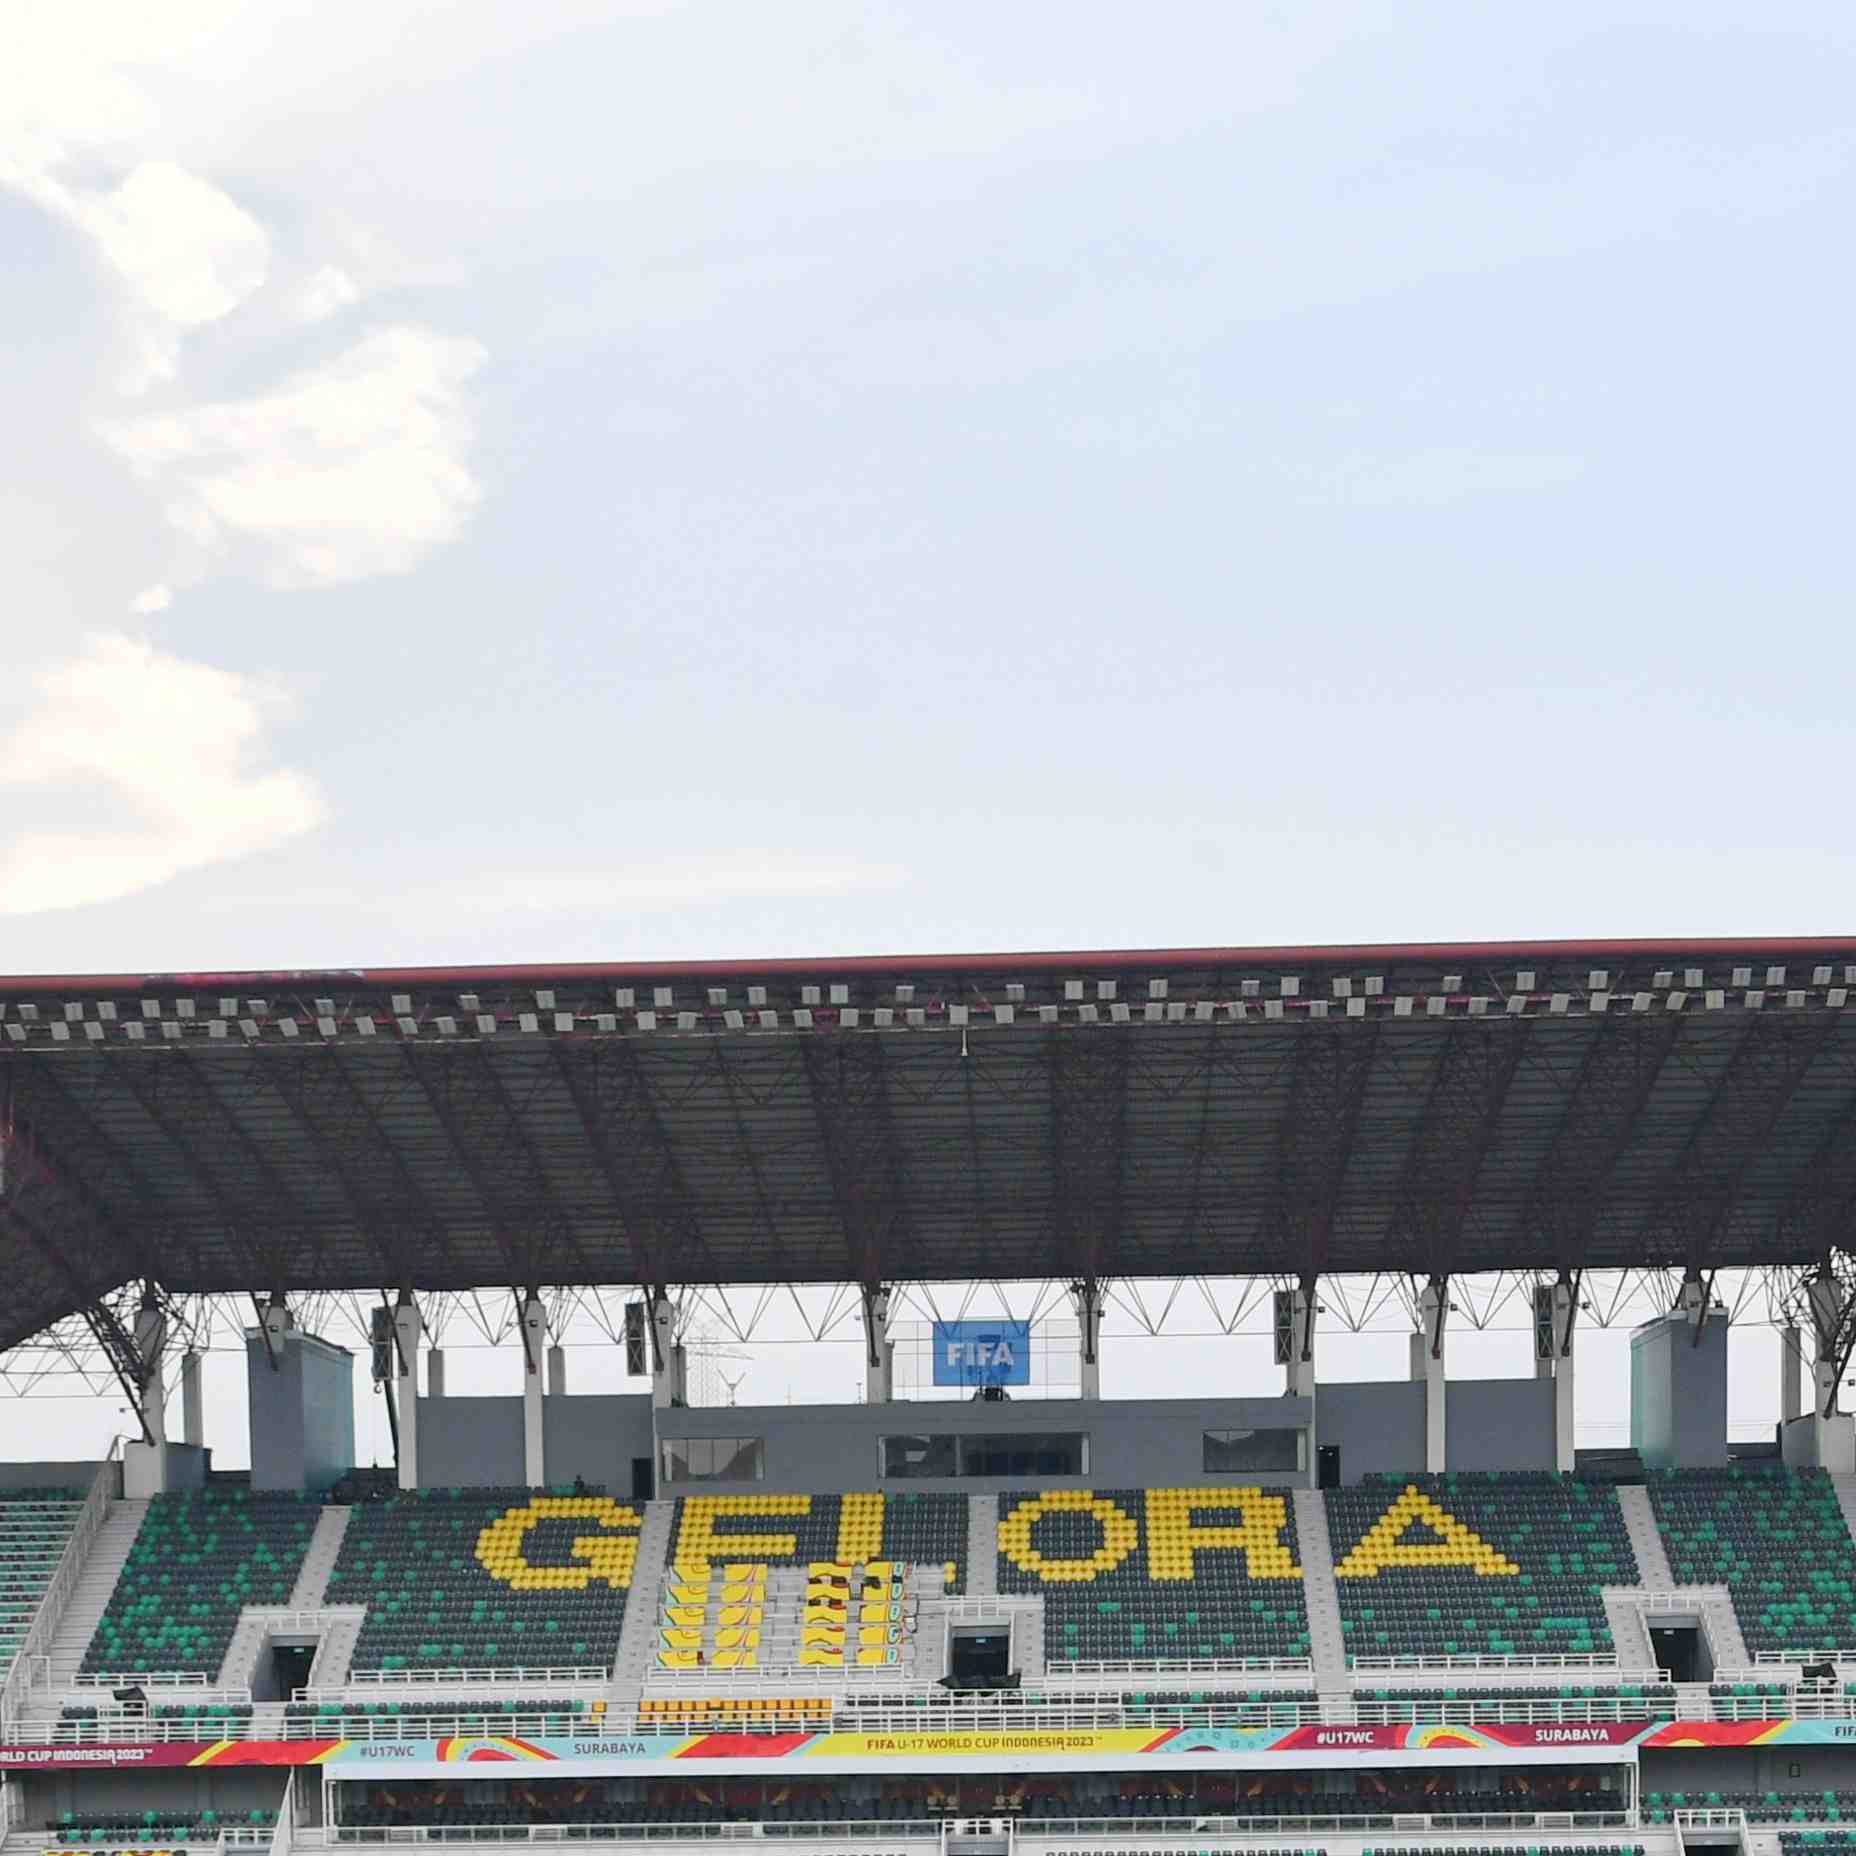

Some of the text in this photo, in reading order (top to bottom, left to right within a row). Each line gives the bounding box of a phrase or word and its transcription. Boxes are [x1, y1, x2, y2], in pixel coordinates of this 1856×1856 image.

[947, 1343, 1014, 1367] FIFA
[1316, 1731, 1374, 1744] #U17WC
[1535, 1729, 1609, 1742] SURABAYA
[573, 1743, 646, 1755] SURABAYA
[867, 1739, 894, 1750] FIFA
[897, 1739, 924, 1749] U-17
[926, 1738, 972, 1749] WORLD
[974, 1738, 999, 1748] CUP
[1001, 1737, 1065, 1750] INDONESIA
[27, 1750, 52, 1762] CUP
[360, 1745, 415, 1757] #U17WC
